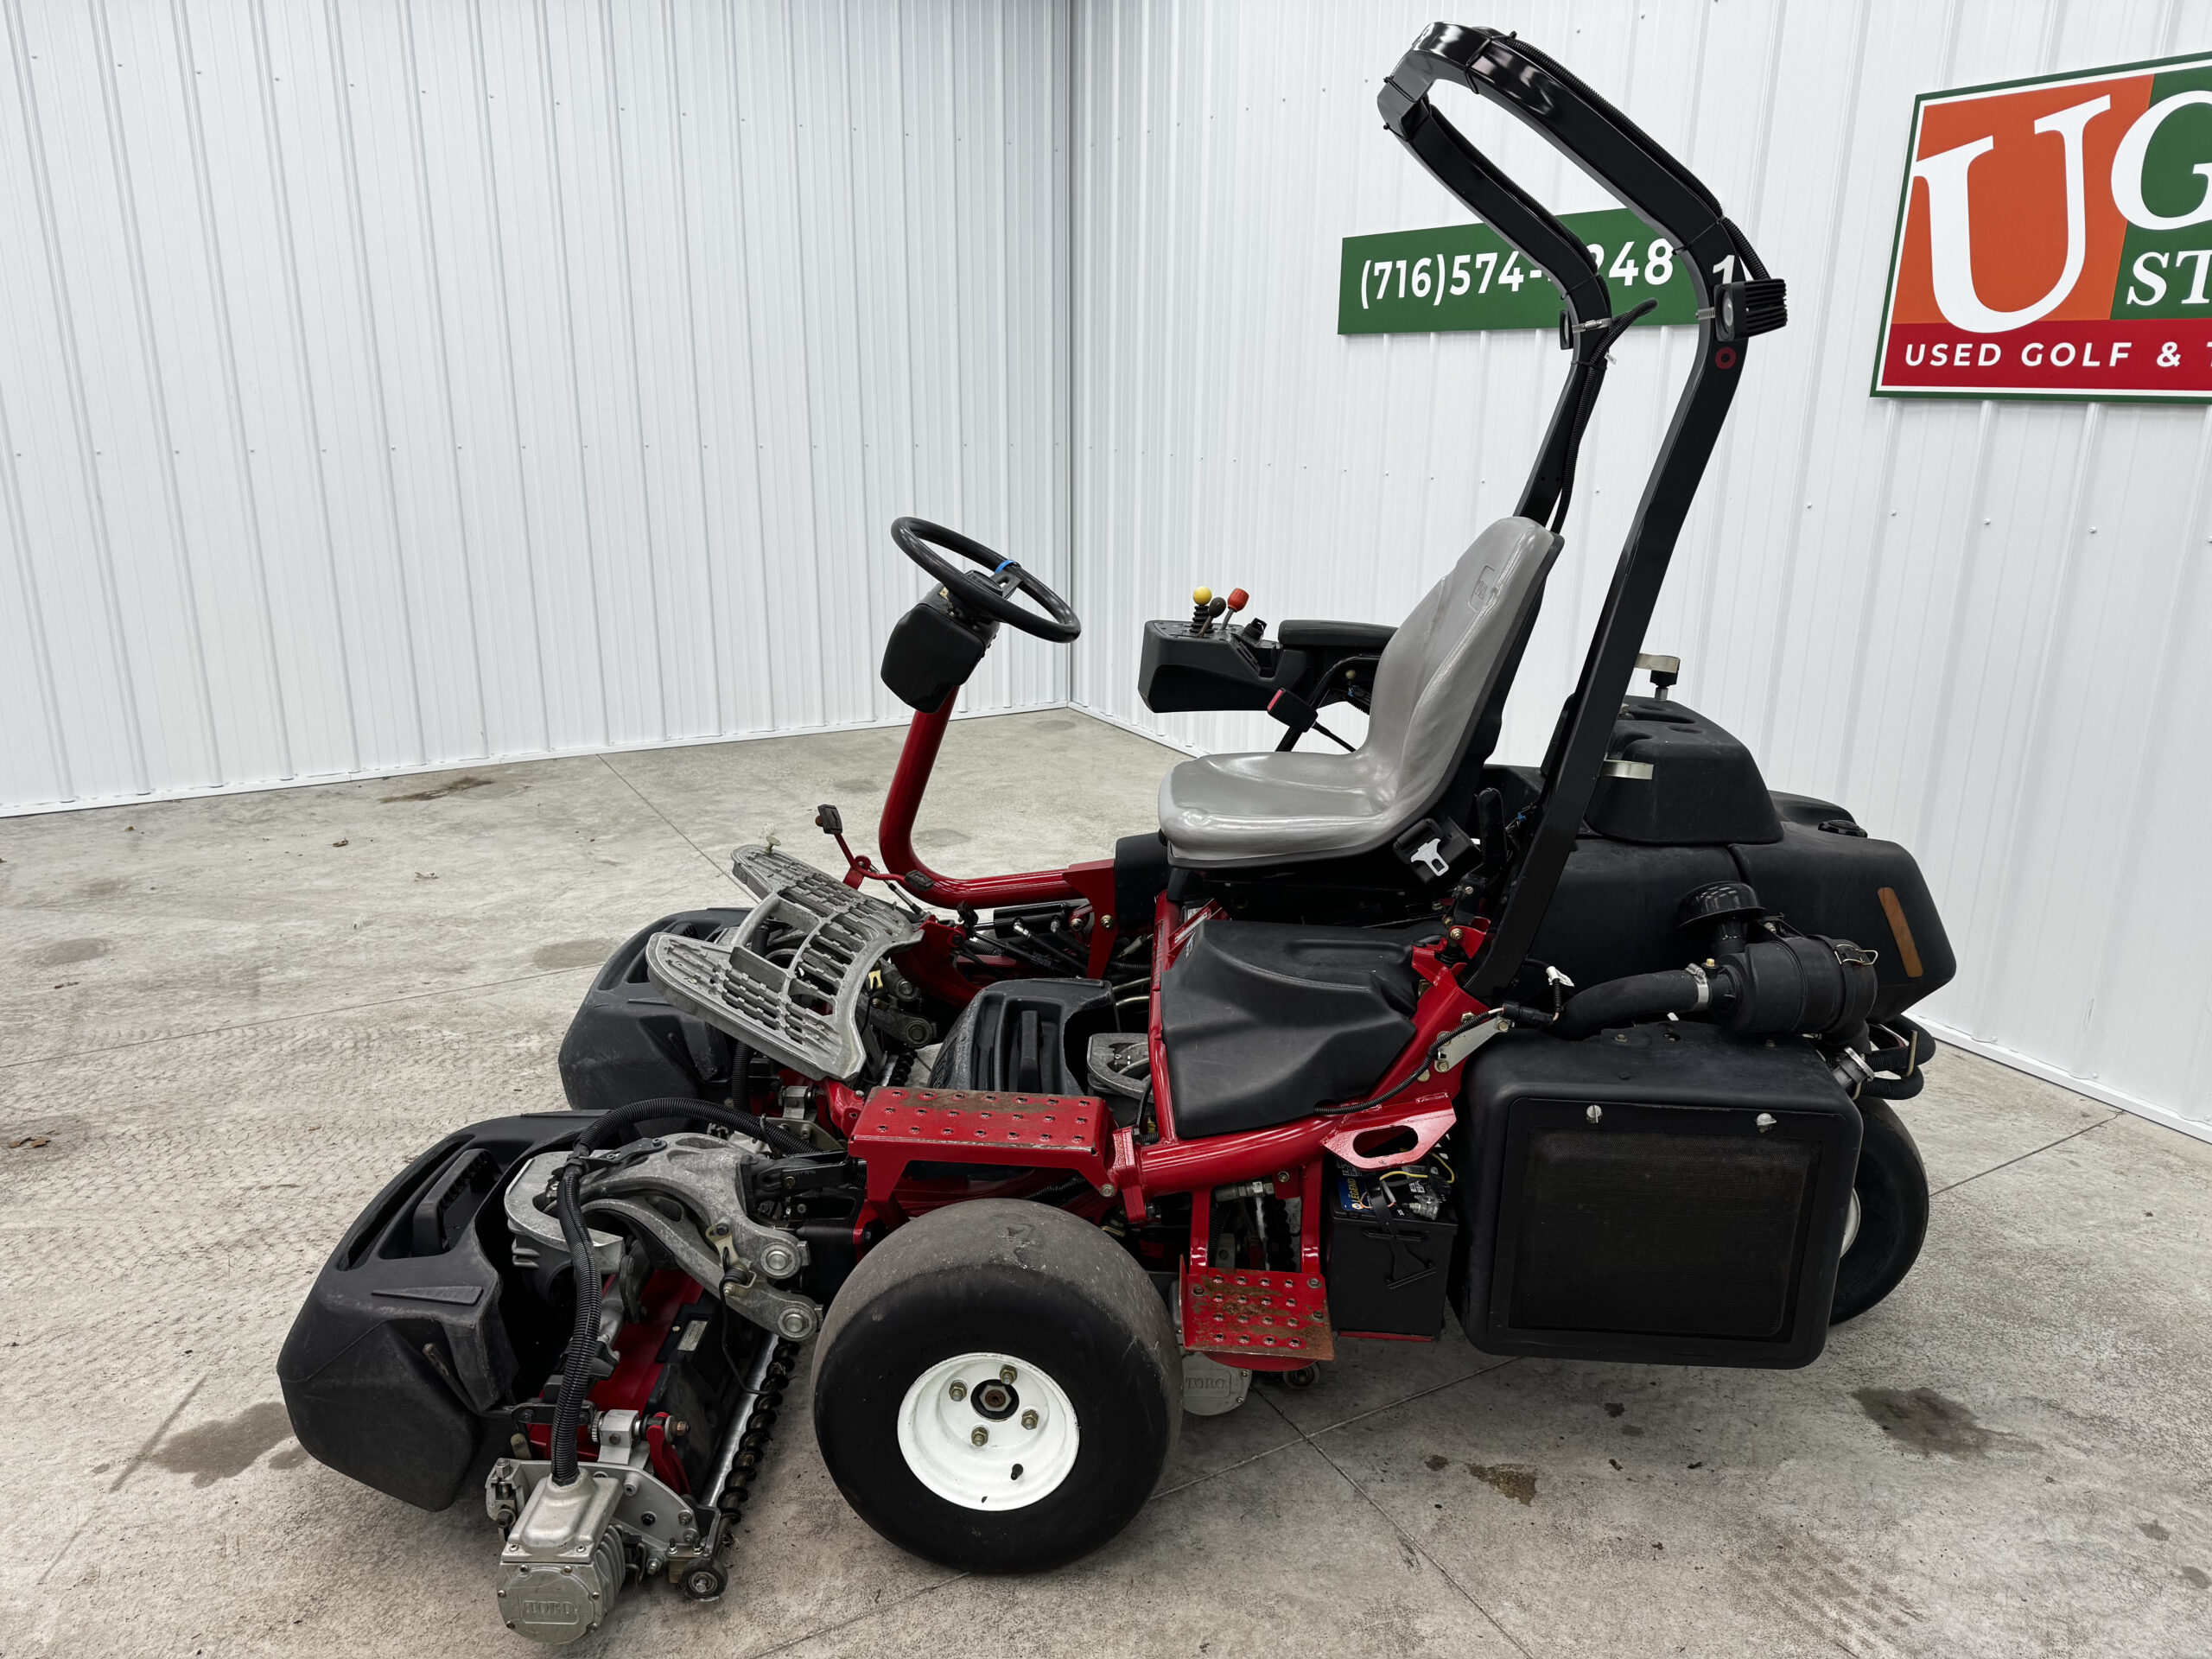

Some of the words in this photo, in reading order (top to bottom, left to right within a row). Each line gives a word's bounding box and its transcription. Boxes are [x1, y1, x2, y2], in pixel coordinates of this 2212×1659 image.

[1361, 238, 1674, 310] (716)574-48
[1904, 343, 2002, 366] USED
[2021, 342, 2133, 367] GOLF
[2157, 341, 2182, 367] &
[1347, 1178, 1361, 1203] LEGEND
[1185, 1377, 1226, 1389] TORO
